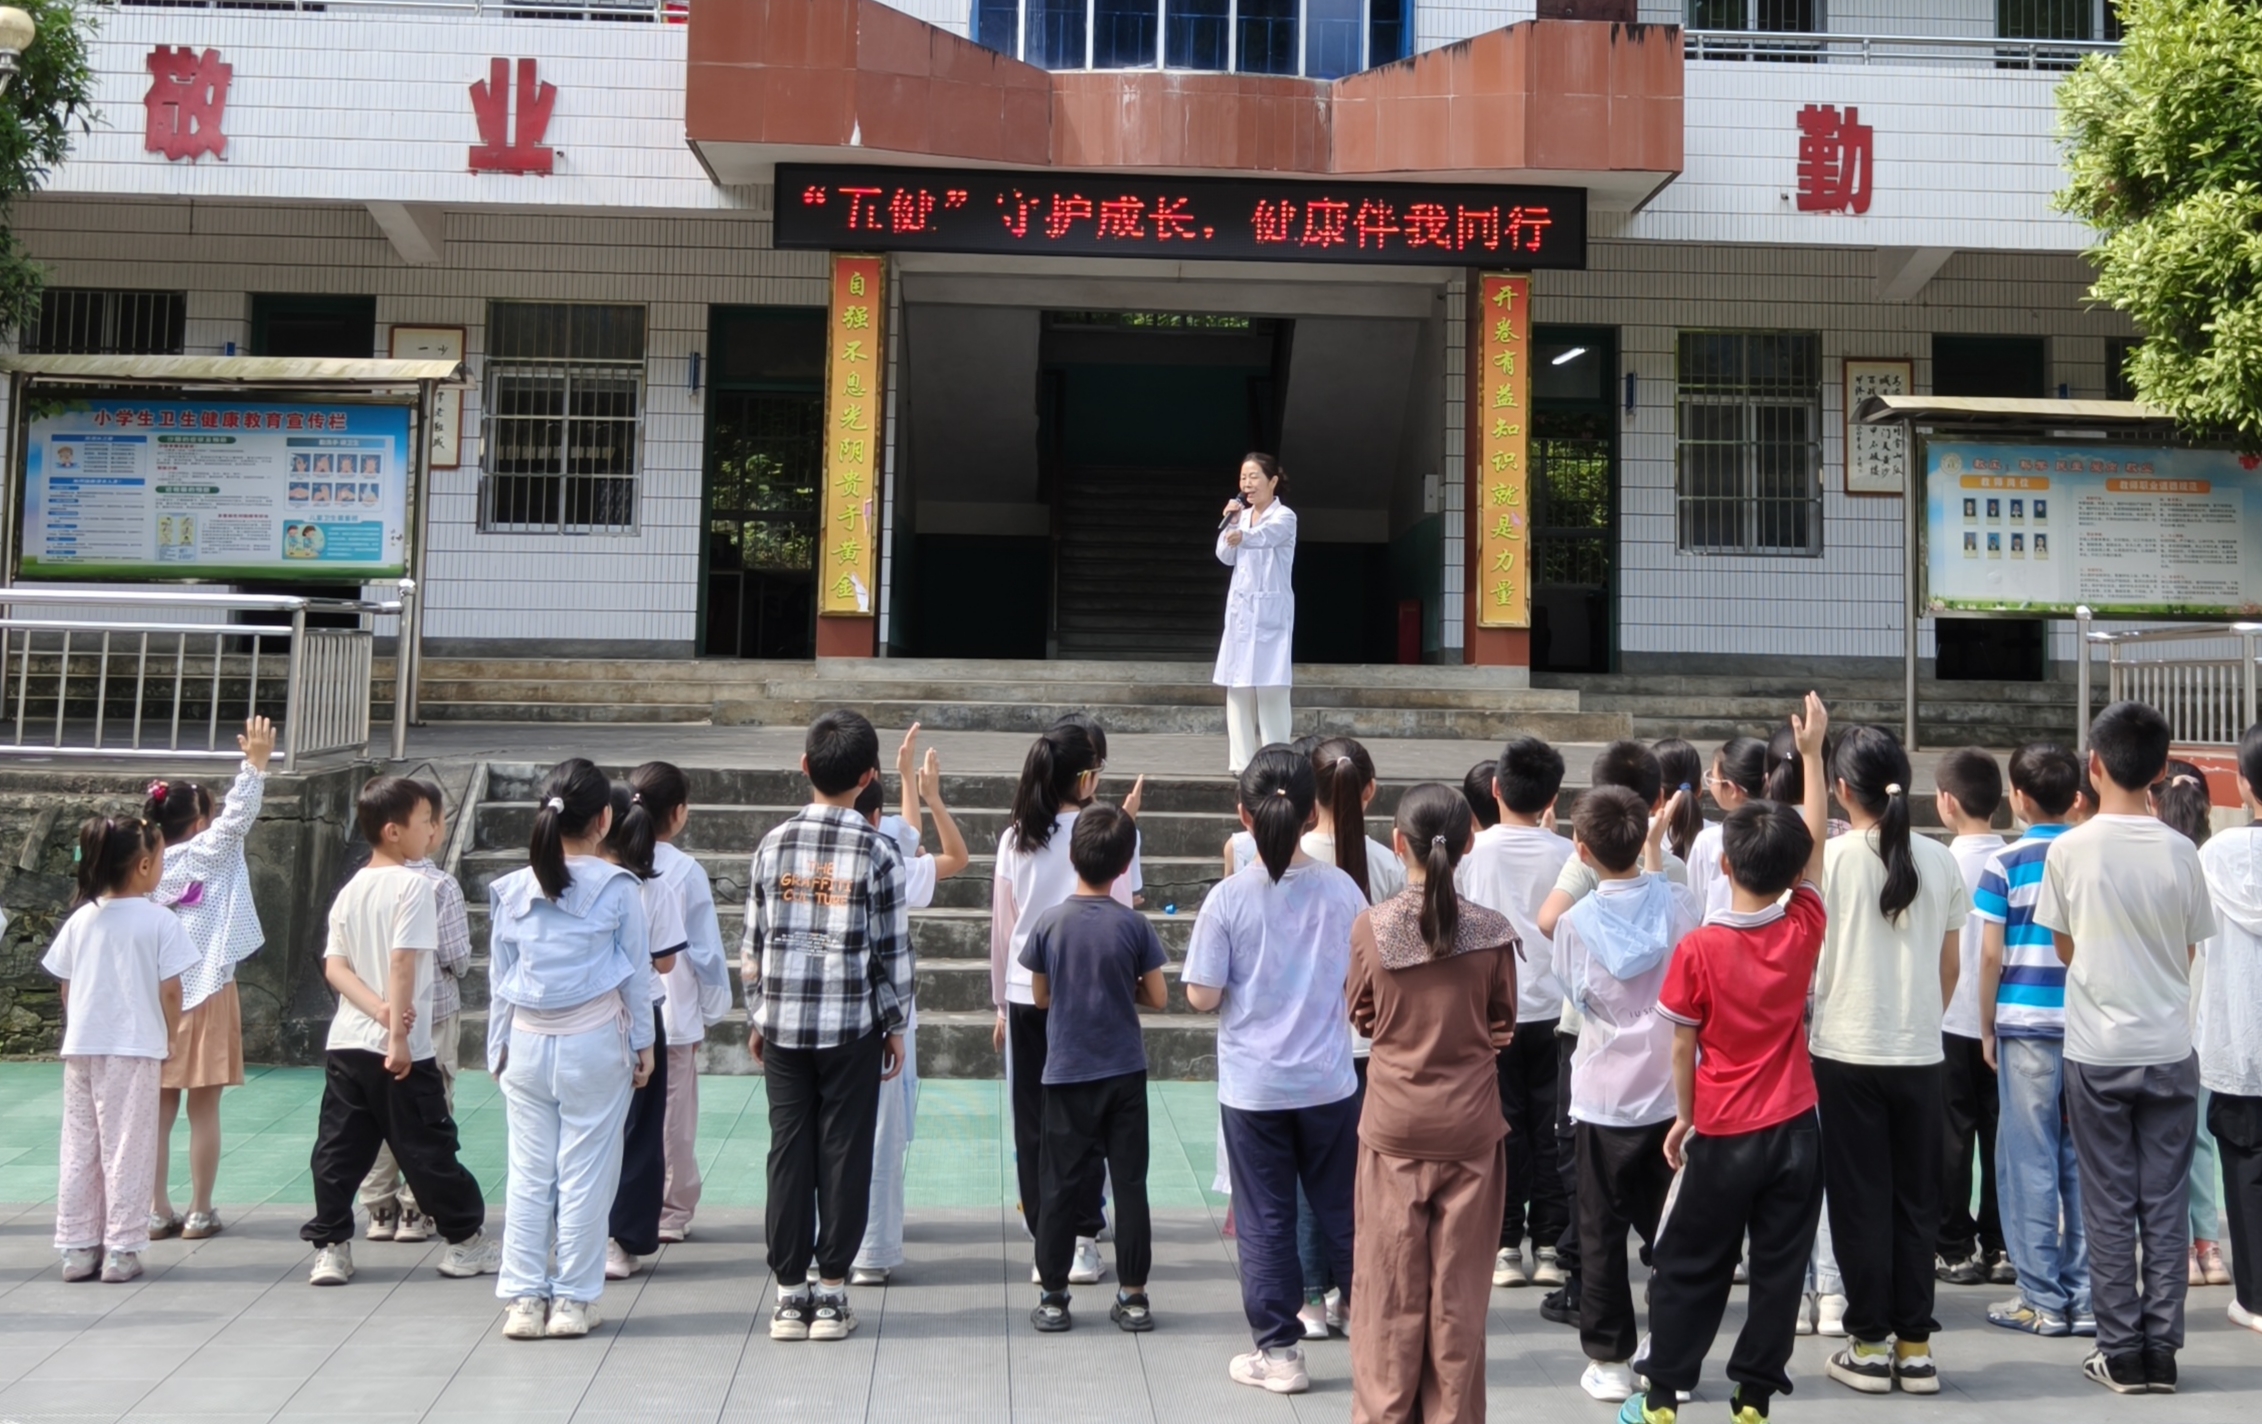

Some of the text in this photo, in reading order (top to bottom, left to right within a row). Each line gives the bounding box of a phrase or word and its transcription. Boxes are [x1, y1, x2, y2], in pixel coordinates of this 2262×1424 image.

[144, 44, 558, 176] 敬 业
[1796, 104, 1873, 216] 勤
[94, 409, 347, 431] 小学生卫生健康教育宣传栏
[831, 271, 870, 599] 自强不息光阴贵于黄金
[1490, 284, 1521, 606] 开卷有益知识就是力量
[1981, 476, 2030, 489] 教师岗位
[2118, 479, 2199, 492] 教师职业道德规范
[807, 859, 835, 876] THE
[780, 872, 853, 893] GRAFFITI
